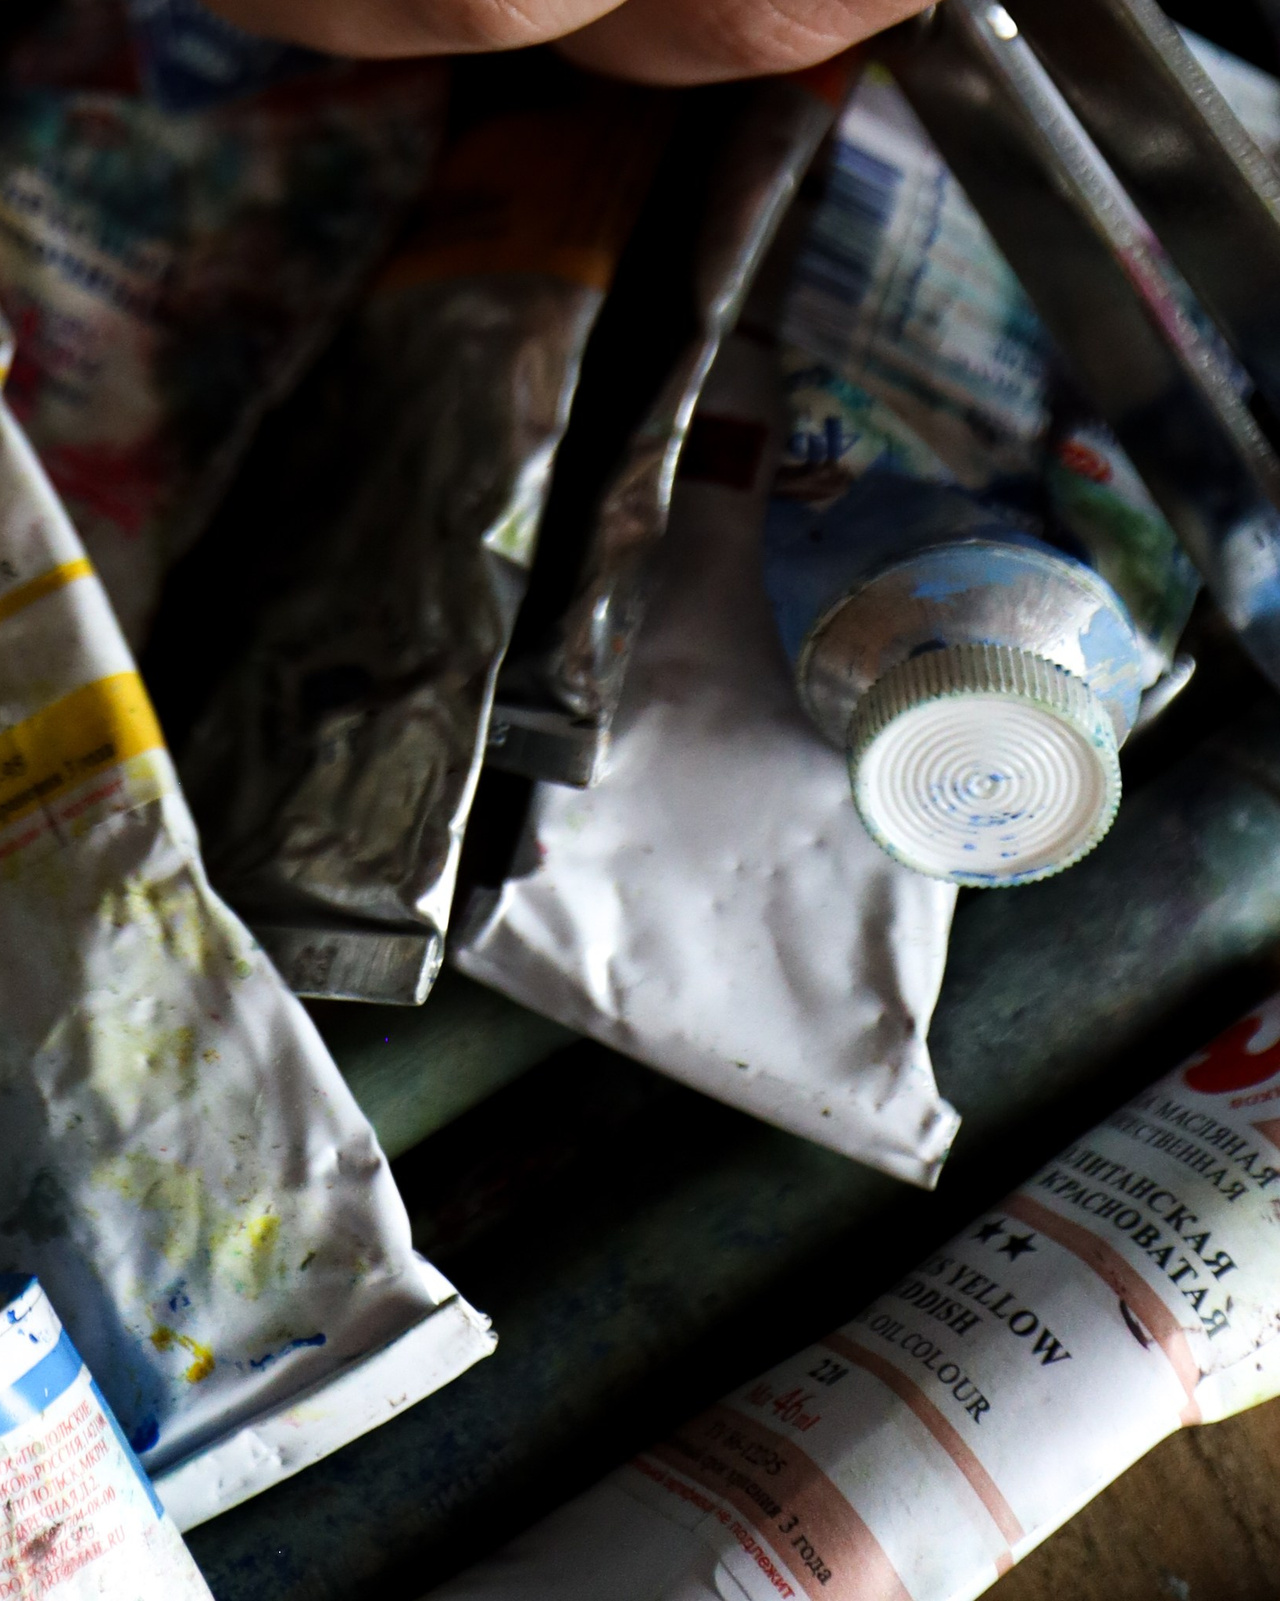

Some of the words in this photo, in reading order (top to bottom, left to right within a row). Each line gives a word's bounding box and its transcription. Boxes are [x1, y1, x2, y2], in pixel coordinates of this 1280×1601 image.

[1156, 1099, 1280, 1189] МАСЛЯНАЯ
[1038, 1170, 1231, 1340] КРАСНОВАТАЯ
[946, 1264, 1072, 1366] YELLOW
[869, 1313, 905, 1343] OIL
[900, 1333, 991, 1424] COLOUR
[729, 1520, 795, 1599] подлежит
[778, 1516, 799, 1534] 3
[791, 1534, 832, 1586] года
